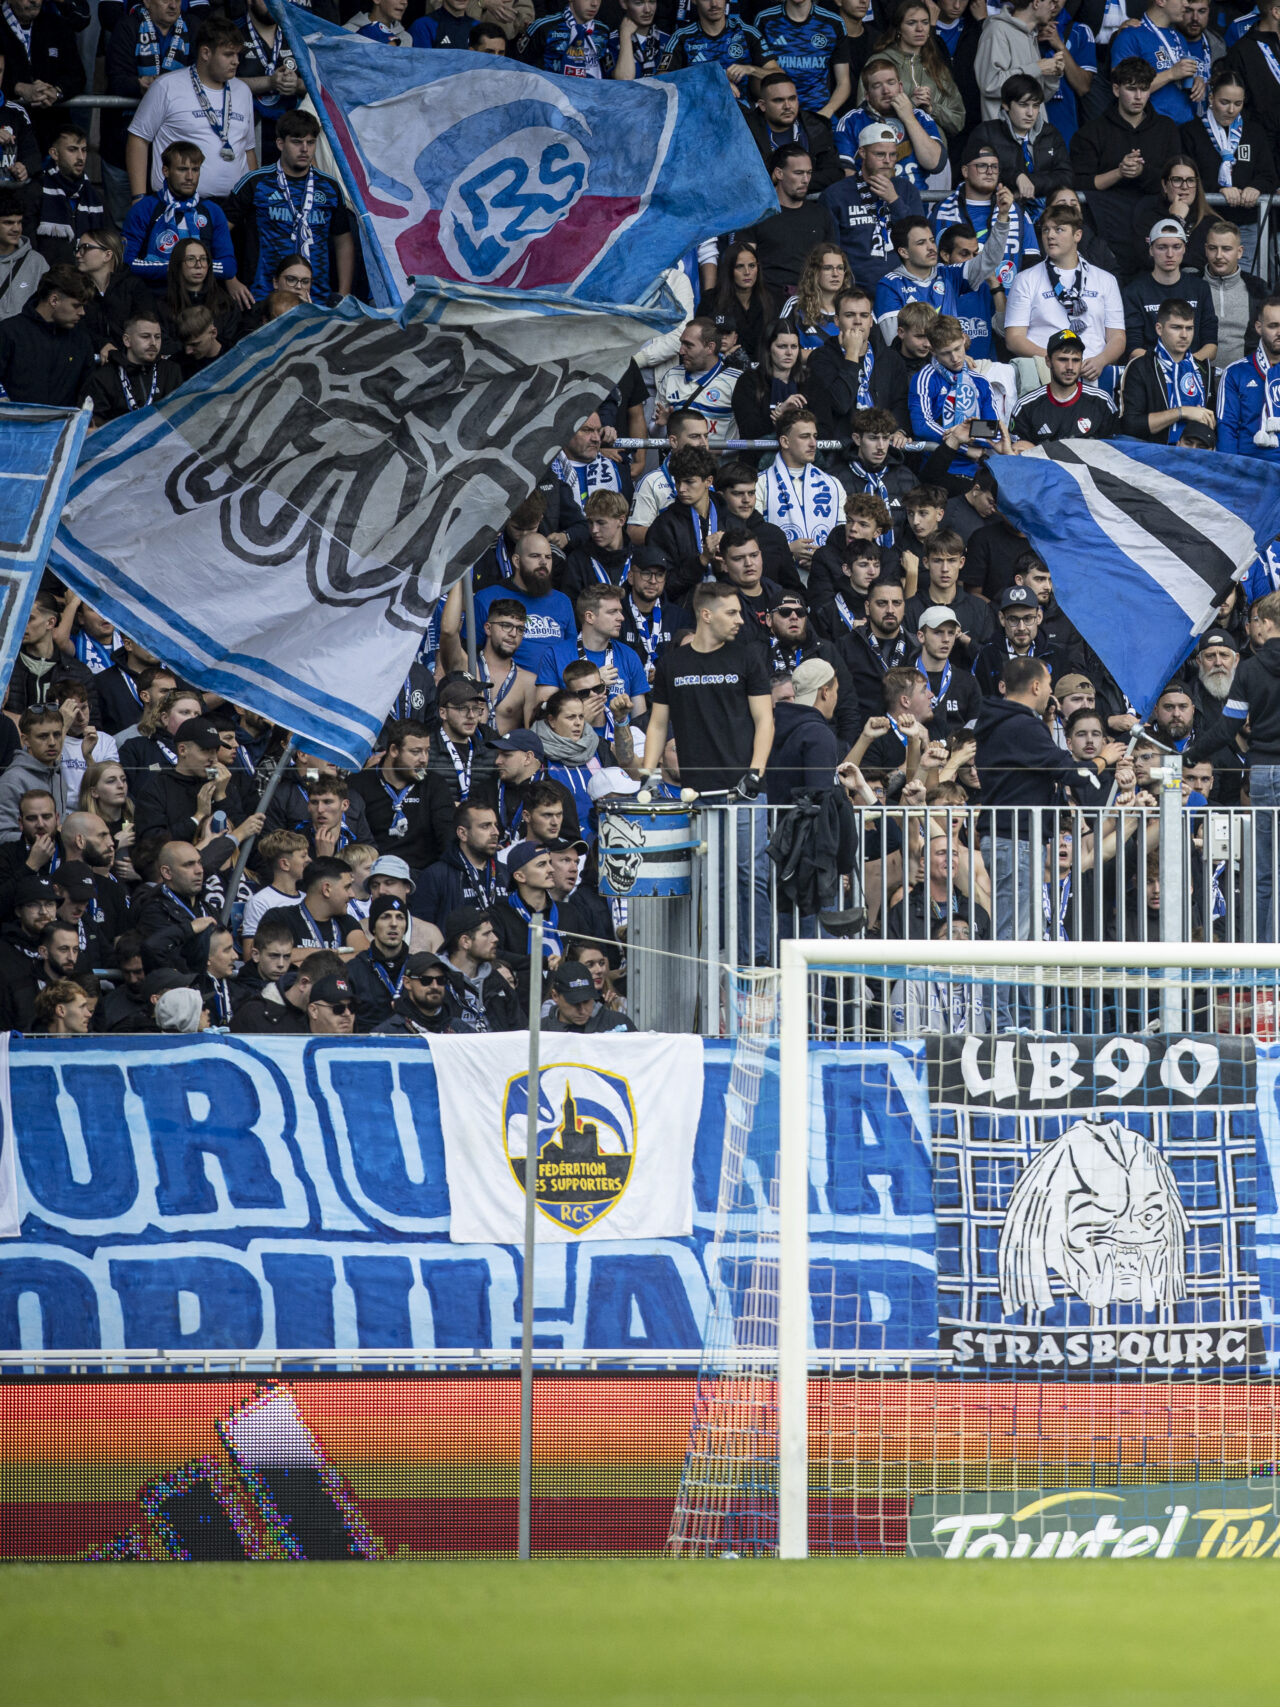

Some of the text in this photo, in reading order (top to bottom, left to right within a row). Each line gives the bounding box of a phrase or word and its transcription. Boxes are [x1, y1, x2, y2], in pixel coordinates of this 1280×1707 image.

[268, 206, 326, 225] WINMAX
[524, 627, 561, 638] ASBOURG
[674, 673, 739, 687] ULTRA BOYS 90
[960, 1035, 1221, 1101] UB90
[538, 1160, 607, 1177] FÉDÉRATION
[551, 1177, 623, 1192] SUPPORTERS
[560, 1204, 594, 1223] RCS
[952, 1330, 1248, 1369] STRASBOURG
[930, 1504, 1190, 1558] Tourtel
